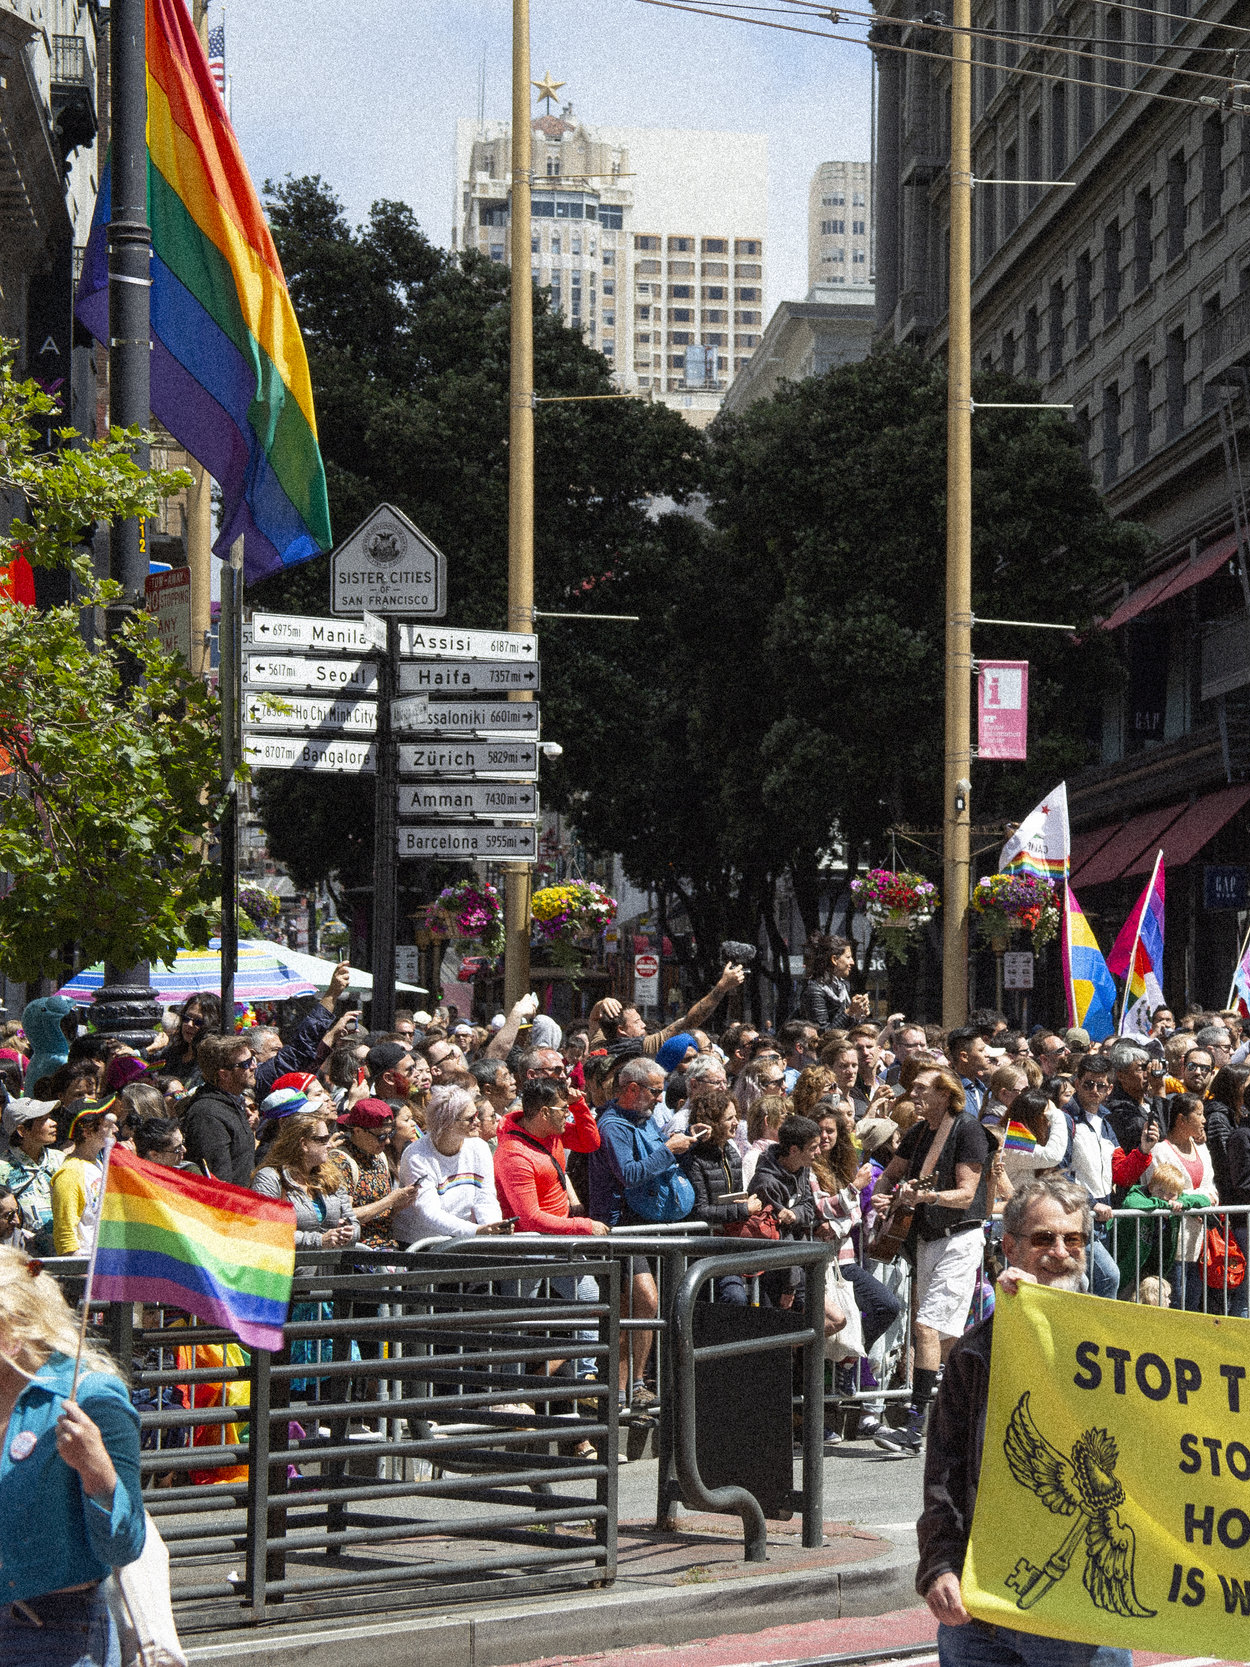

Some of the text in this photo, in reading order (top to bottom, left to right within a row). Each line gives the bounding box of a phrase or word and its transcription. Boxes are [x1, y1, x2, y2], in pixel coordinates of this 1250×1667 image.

[151, 572, 184, 588] TOW-AWAY
[339, 571, 432, 584] SISTER CITIES
[146, 589, 189, 610] NO STOPPING
[342, 595, 428, 605] SAN FRANCISCO
[158, 616, 177, 634] ANY
[272, 624, 301, 638] 6975mi
[312, 625, 366, 644] Manila
[413, 633, 519, 654] Assisi 6187mi
[268, 663, 366, 683] 5617mi Seoul
[419, 669, 521, 685] Haifa 7357mi
[296, 704, 308, 720] Ho
[310, 705, 326, 721] Chi
[329, 706, 352, 722] Minh
[354, 707, 374, 725] City
[428, 709, 486, 725] ssaloniki
[490, 709, 521, 723] 6601mi
[1135, 712, 1159, 729] GAP
[264, 746, 371, 767] 8707mi Bangalore
[413, 750, 518, 766] Zürich 5829mi
[411, 792, 517, 807] Amman 7430mi
[407, 833, 517, 849] Barcelona 5955mi
[1215, 876, 1236, 892] GAP
[1073, 1340, 1202, 1406] STOP
[1167, 1562, 1206, 1607] IS
